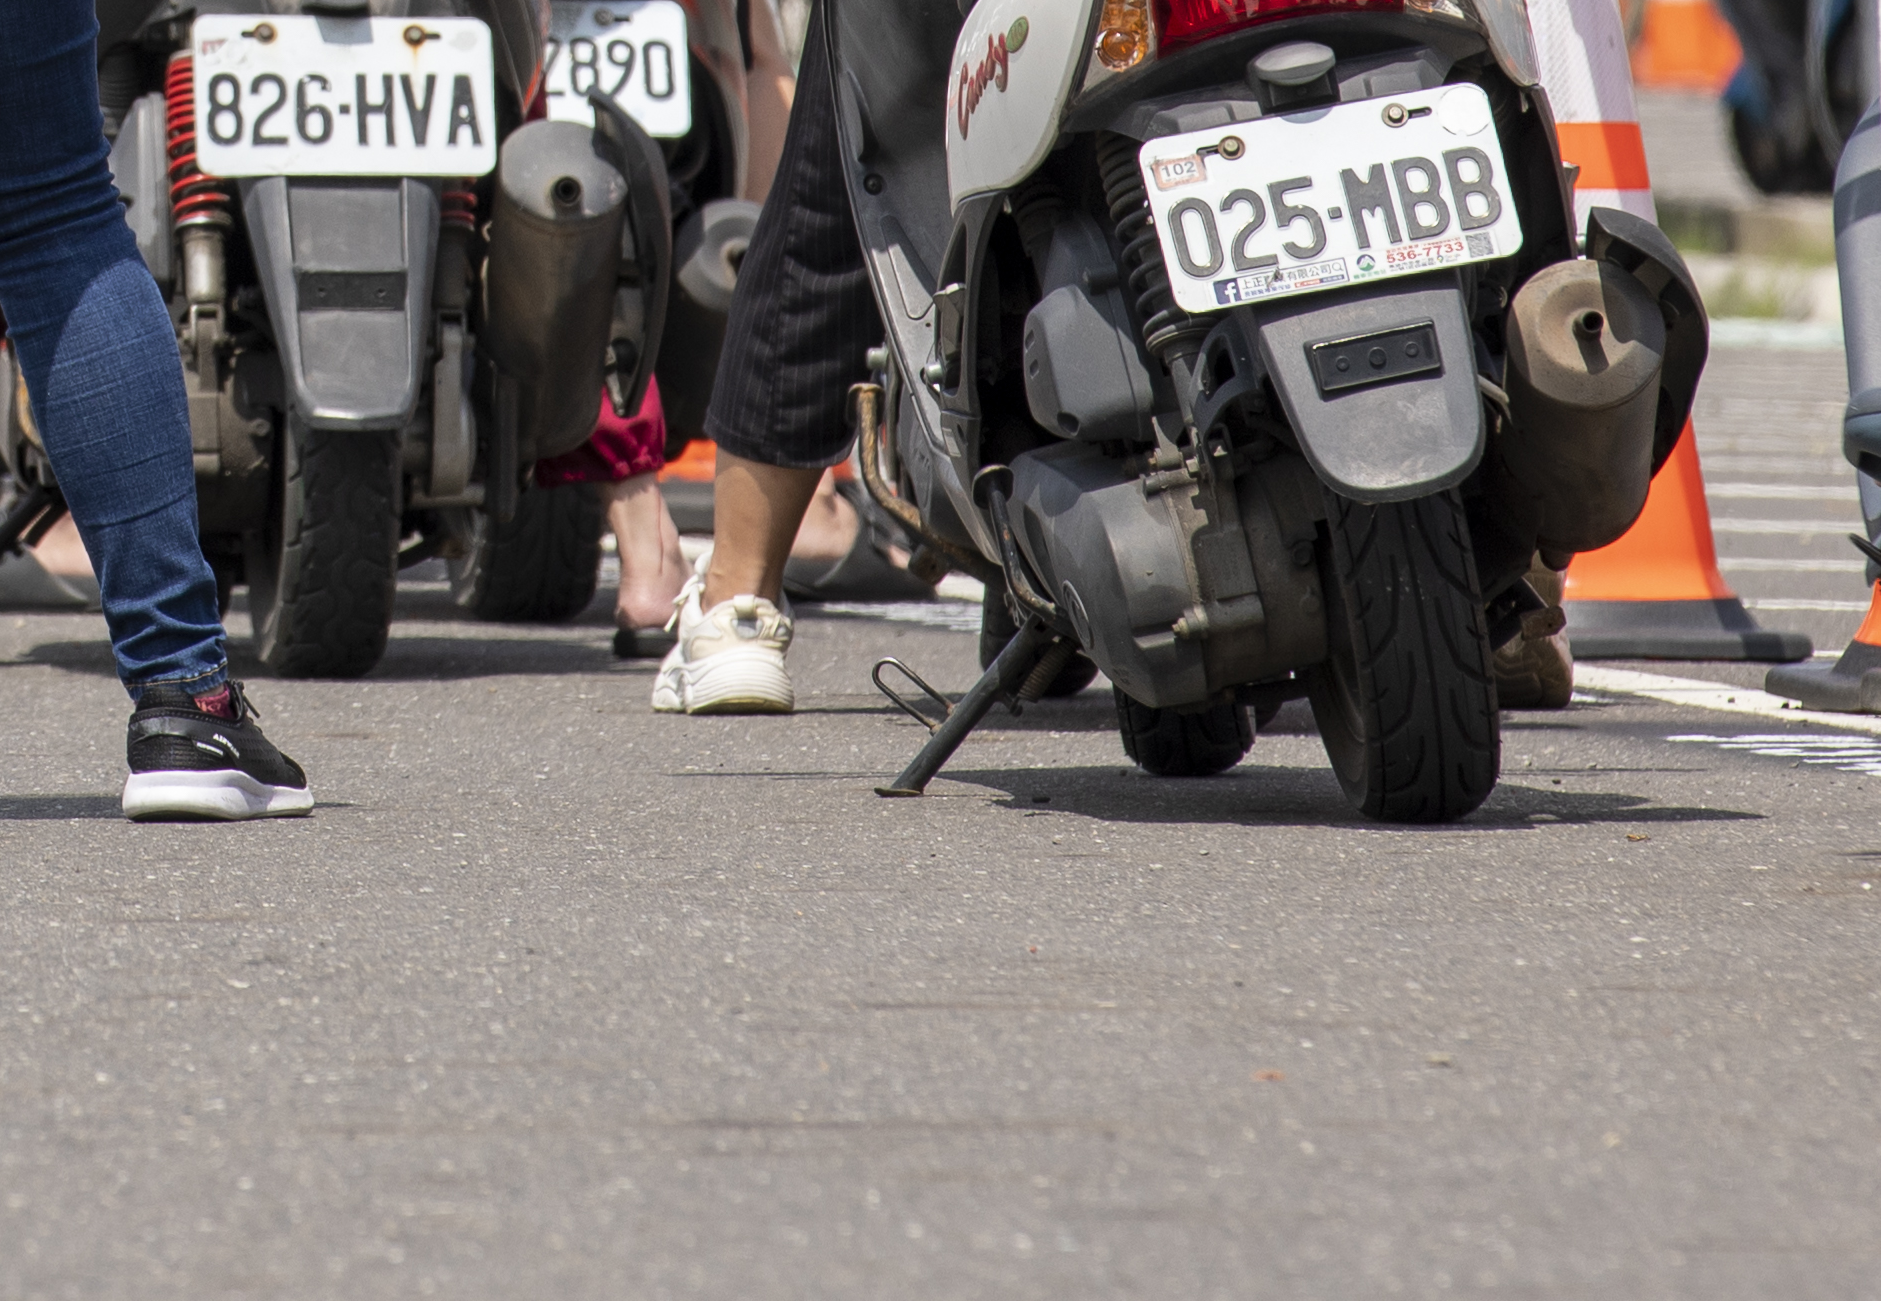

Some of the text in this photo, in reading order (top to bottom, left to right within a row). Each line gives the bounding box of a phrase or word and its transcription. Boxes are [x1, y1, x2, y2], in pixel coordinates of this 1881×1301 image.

[207, 72, 483, 147] 826-HVA
[957, 32, 1009, 141] Candy
[1161, 161, 1196, 177] 102
[1167, 146, 1503, 278] 025-MBB
[1242, 263, 1332, 290] 上正有限公司
[1386, 241, 1464, 264] 536-7733
